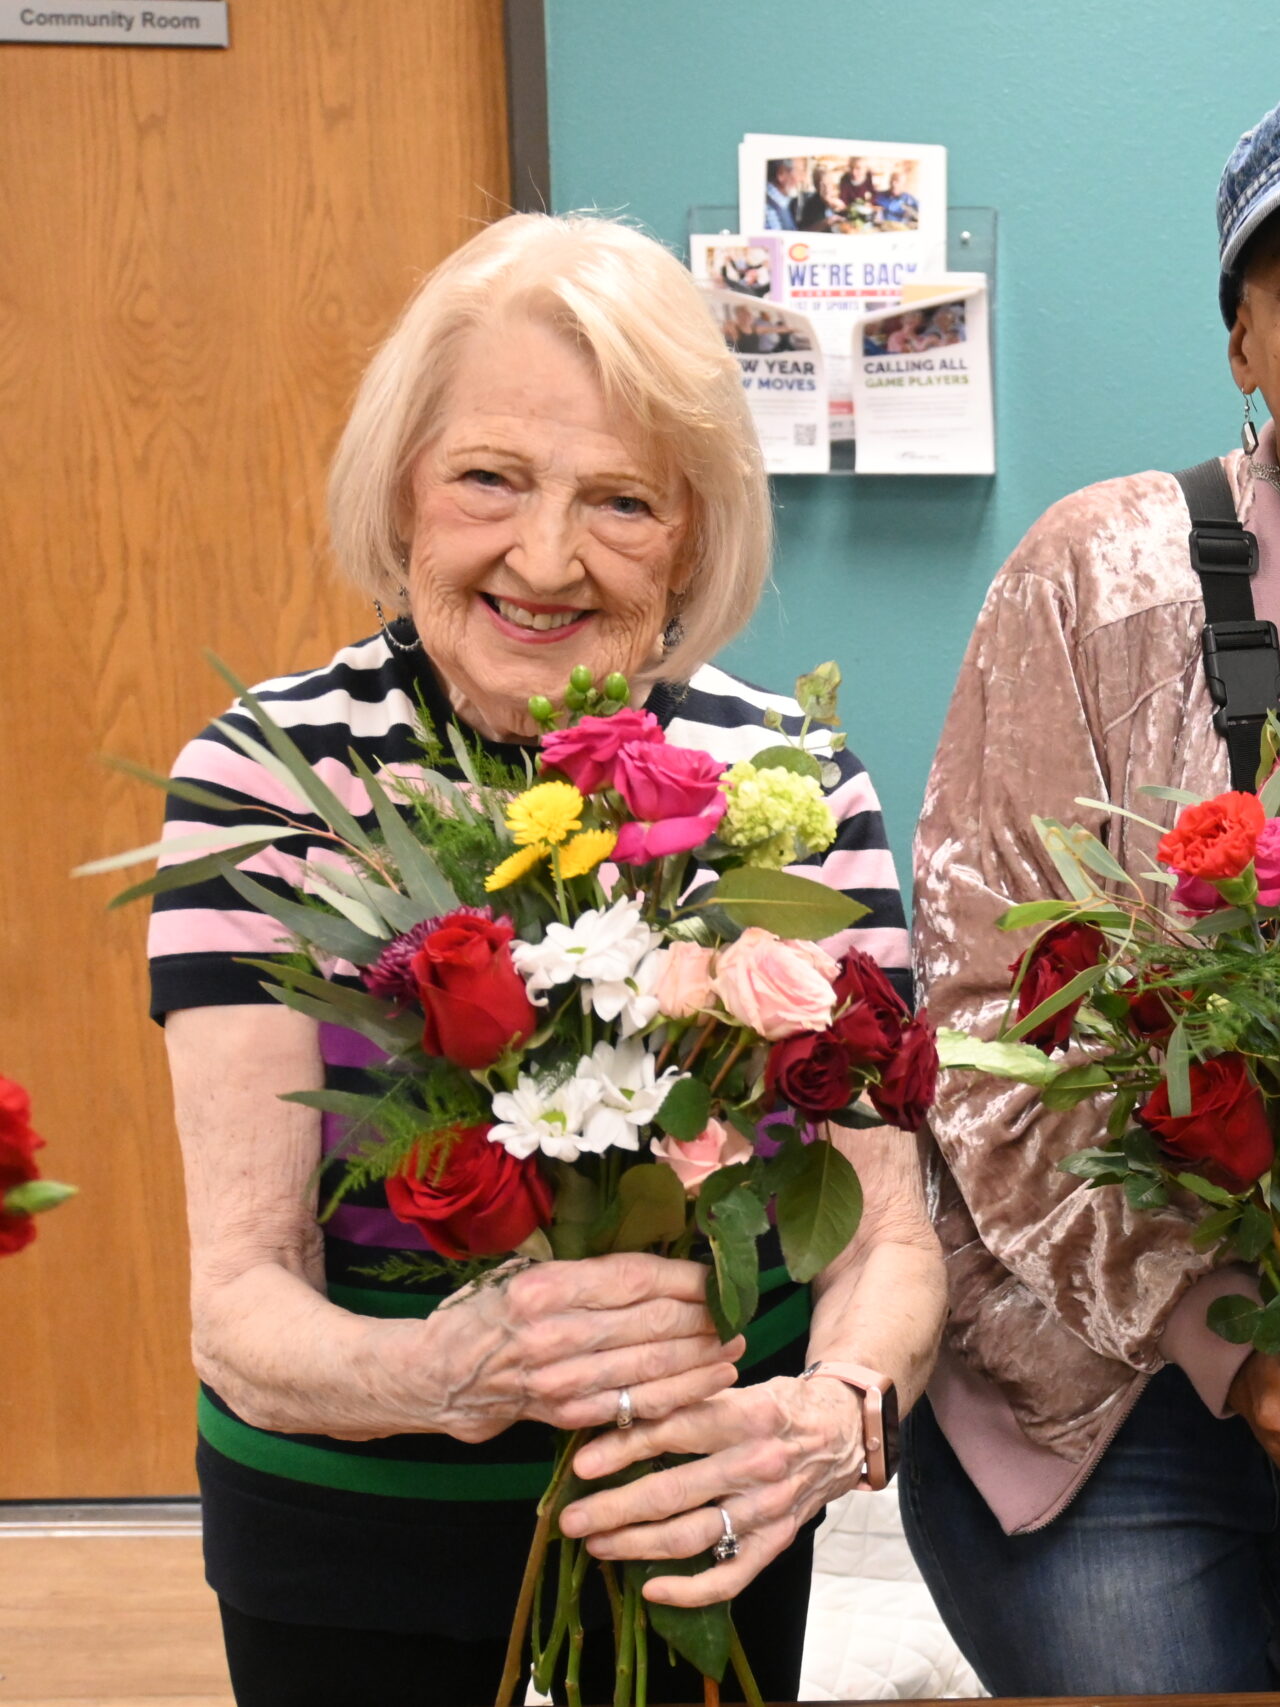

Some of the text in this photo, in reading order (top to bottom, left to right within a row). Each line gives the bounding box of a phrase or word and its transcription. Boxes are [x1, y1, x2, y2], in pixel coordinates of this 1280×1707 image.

[20, 9, 201, 31] Community Room
[788, 263, 854, 287] WE'RE
[764, 359, 815, 375] YEAR
[864, 359, 968, 375] CALLING ALL
[758, 377, 817, 392] MOVES
[865, 374, 970, 388] GAME PLAYERS
